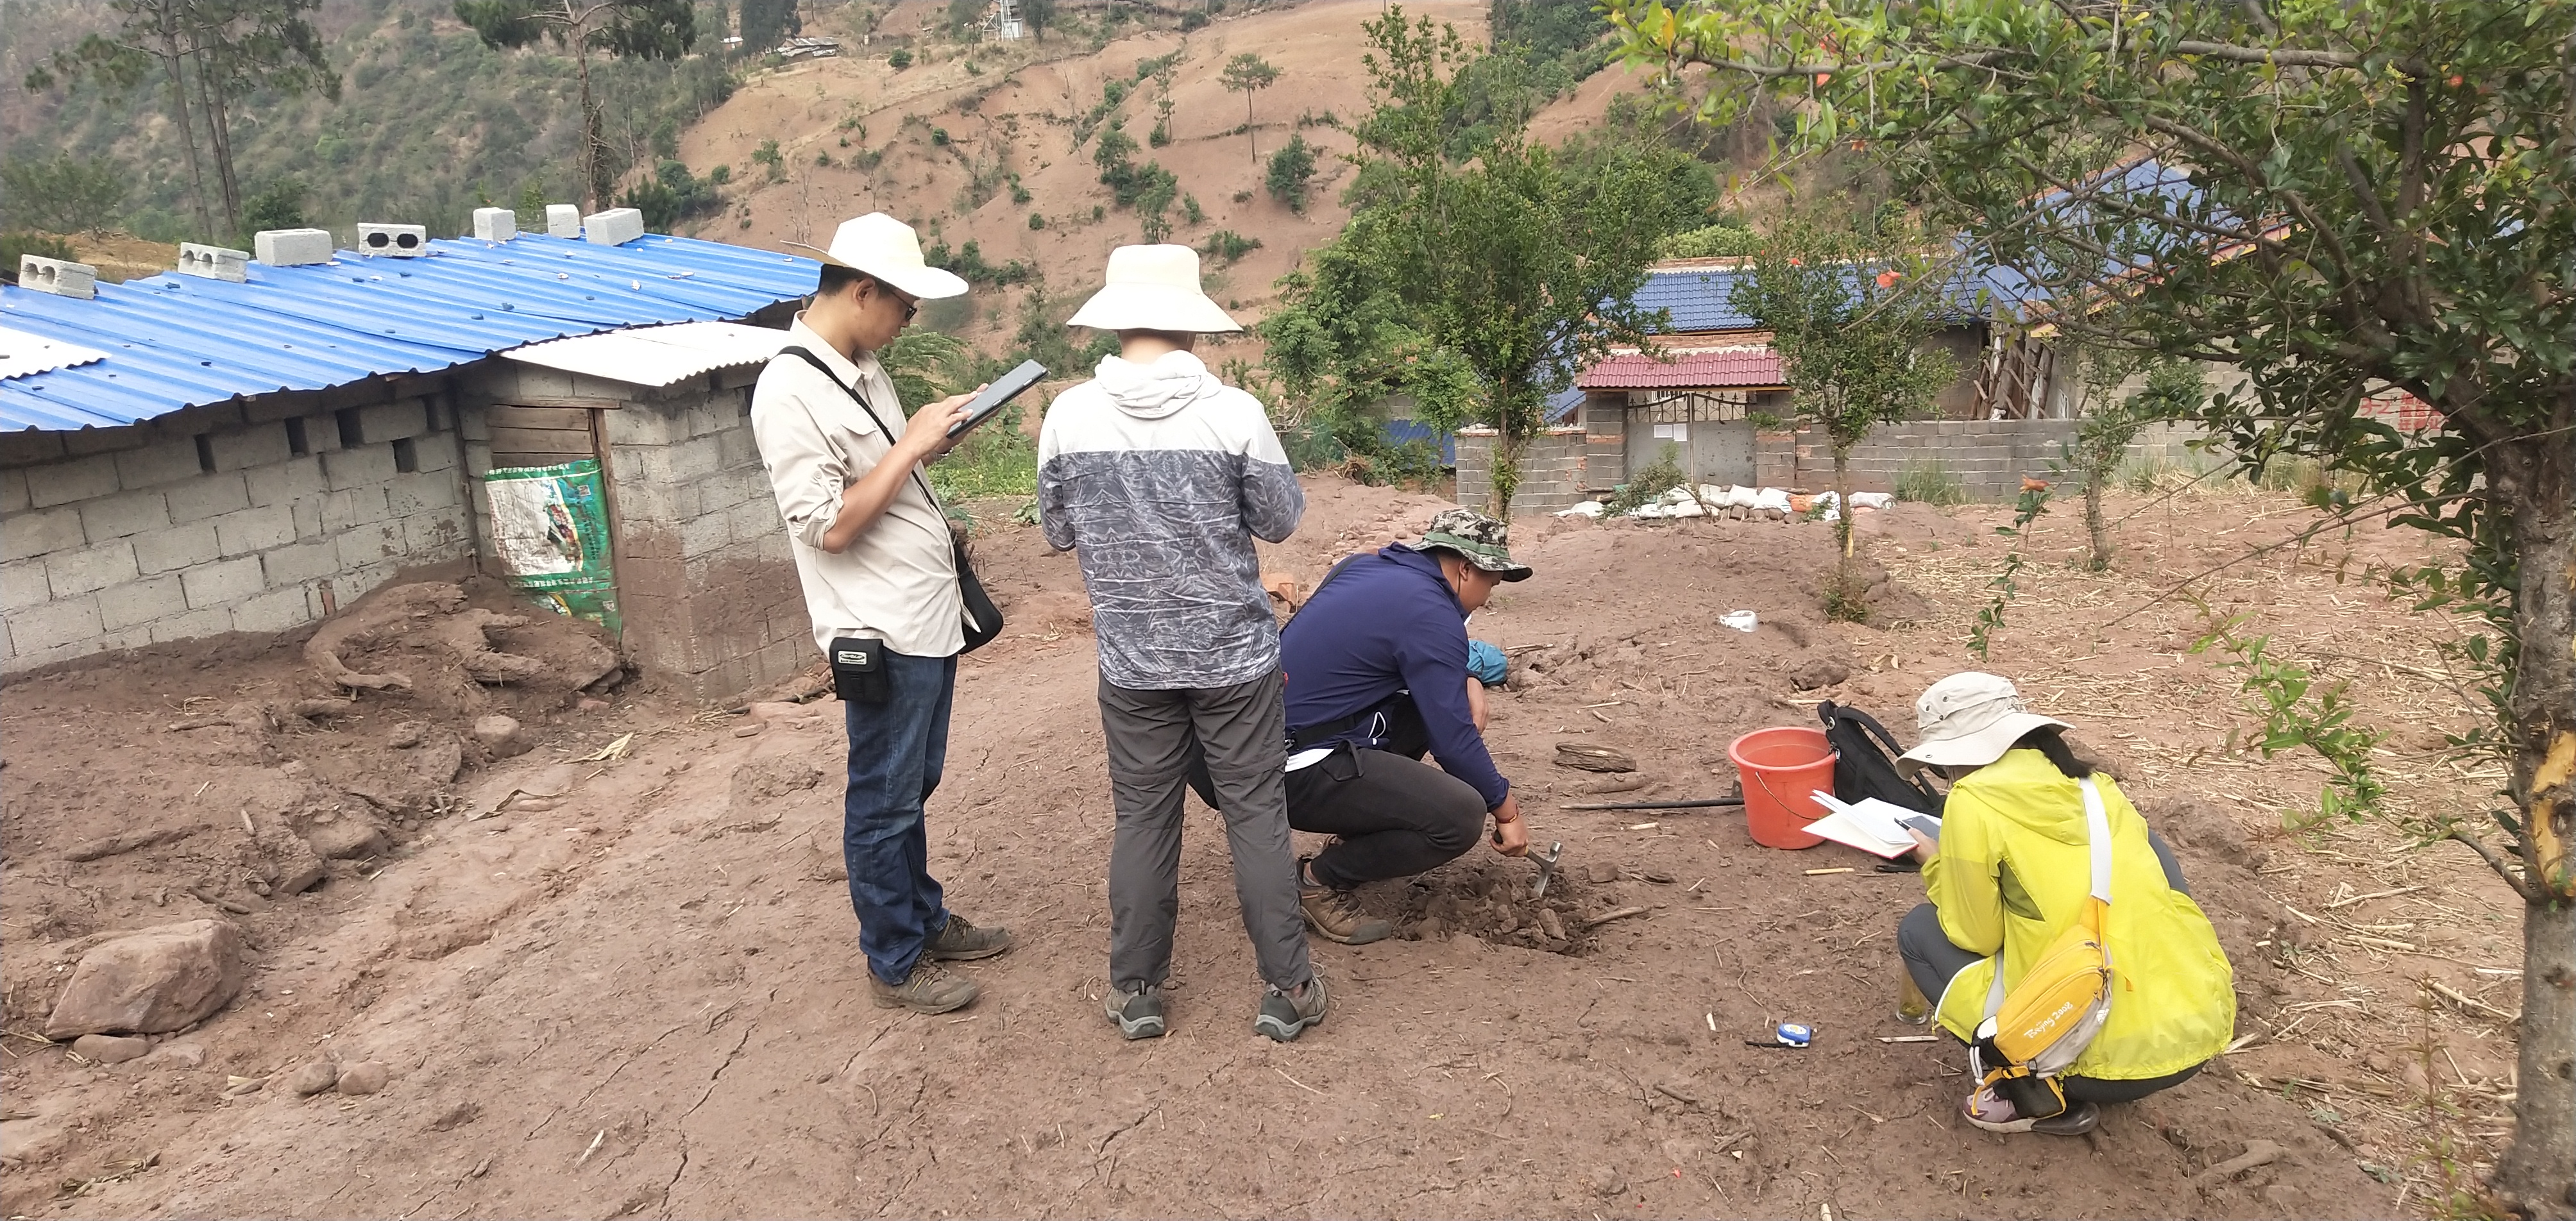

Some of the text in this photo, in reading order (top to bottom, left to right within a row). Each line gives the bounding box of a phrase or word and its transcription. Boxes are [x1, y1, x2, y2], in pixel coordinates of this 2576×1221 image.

[2360, 397, 2392, 416] 3-2
[2024, 1001, 2073, 1038] Beijing 2008
